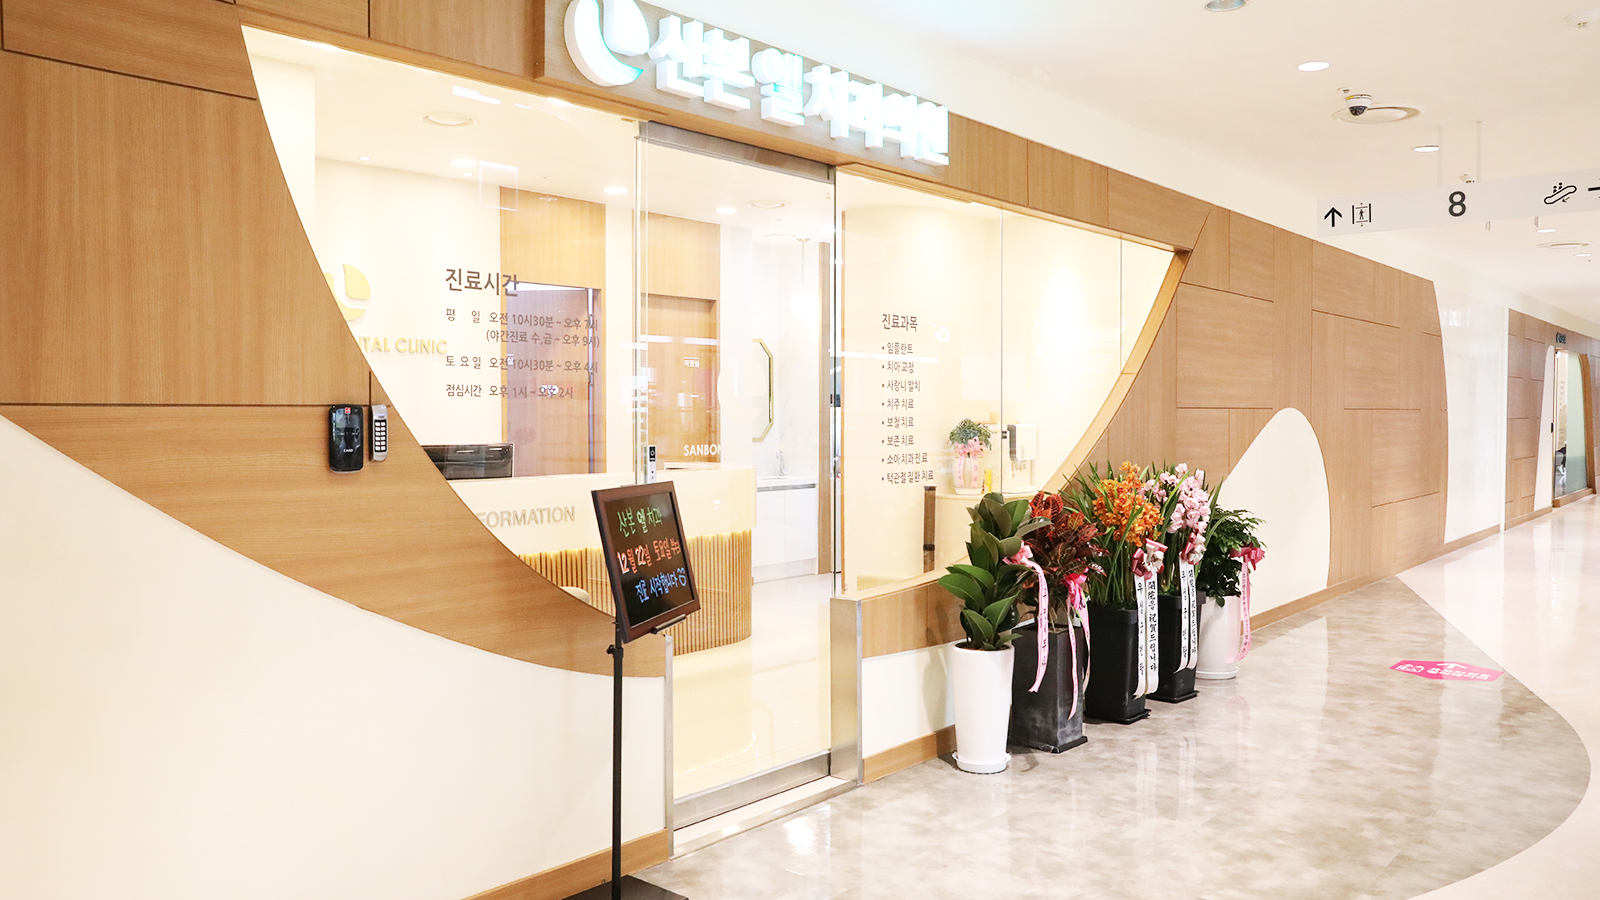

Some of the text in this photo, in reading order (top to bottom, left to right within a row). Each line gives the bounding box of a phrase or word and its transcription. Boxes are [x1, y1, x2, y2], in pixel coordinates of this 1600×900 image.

[1448, 190, 1467, 217] 8
[445, 268, 520, 297] 진료시간
[489, 312, 508, 326] 오전
[512, 314, 554, 329] 10시30분
[564, 317, 582, 331] 오후
[882, 313, 918, 333] 진료과목
[395, 337, 448, 355] CLINIC
[486, 329, 529, 344] (야간진료
[531, 332, 553, 346] 수,금
[562, 334, 581, 347] 오후
[489, 357, 508, 370] 오전
[512, 358, 554, 372] 10시30분
[564, 360, 582, 373] 오후
[445, 383, 482, 398] 점심시간
[489, 385, 508, 398] 오후
[513, 386, 528, 399] 1시
[559, 386, 574, 399] 2시
[617, 507, 636, 538] 산본
[647, 506, 663, 527] 치과
[616, 548, 638, 575] 12월
[634, 544, 653, 567] 22일
[652, 537, 672, 562] 토요일
[635, 571, 678, 603] 진료 시작합니다
